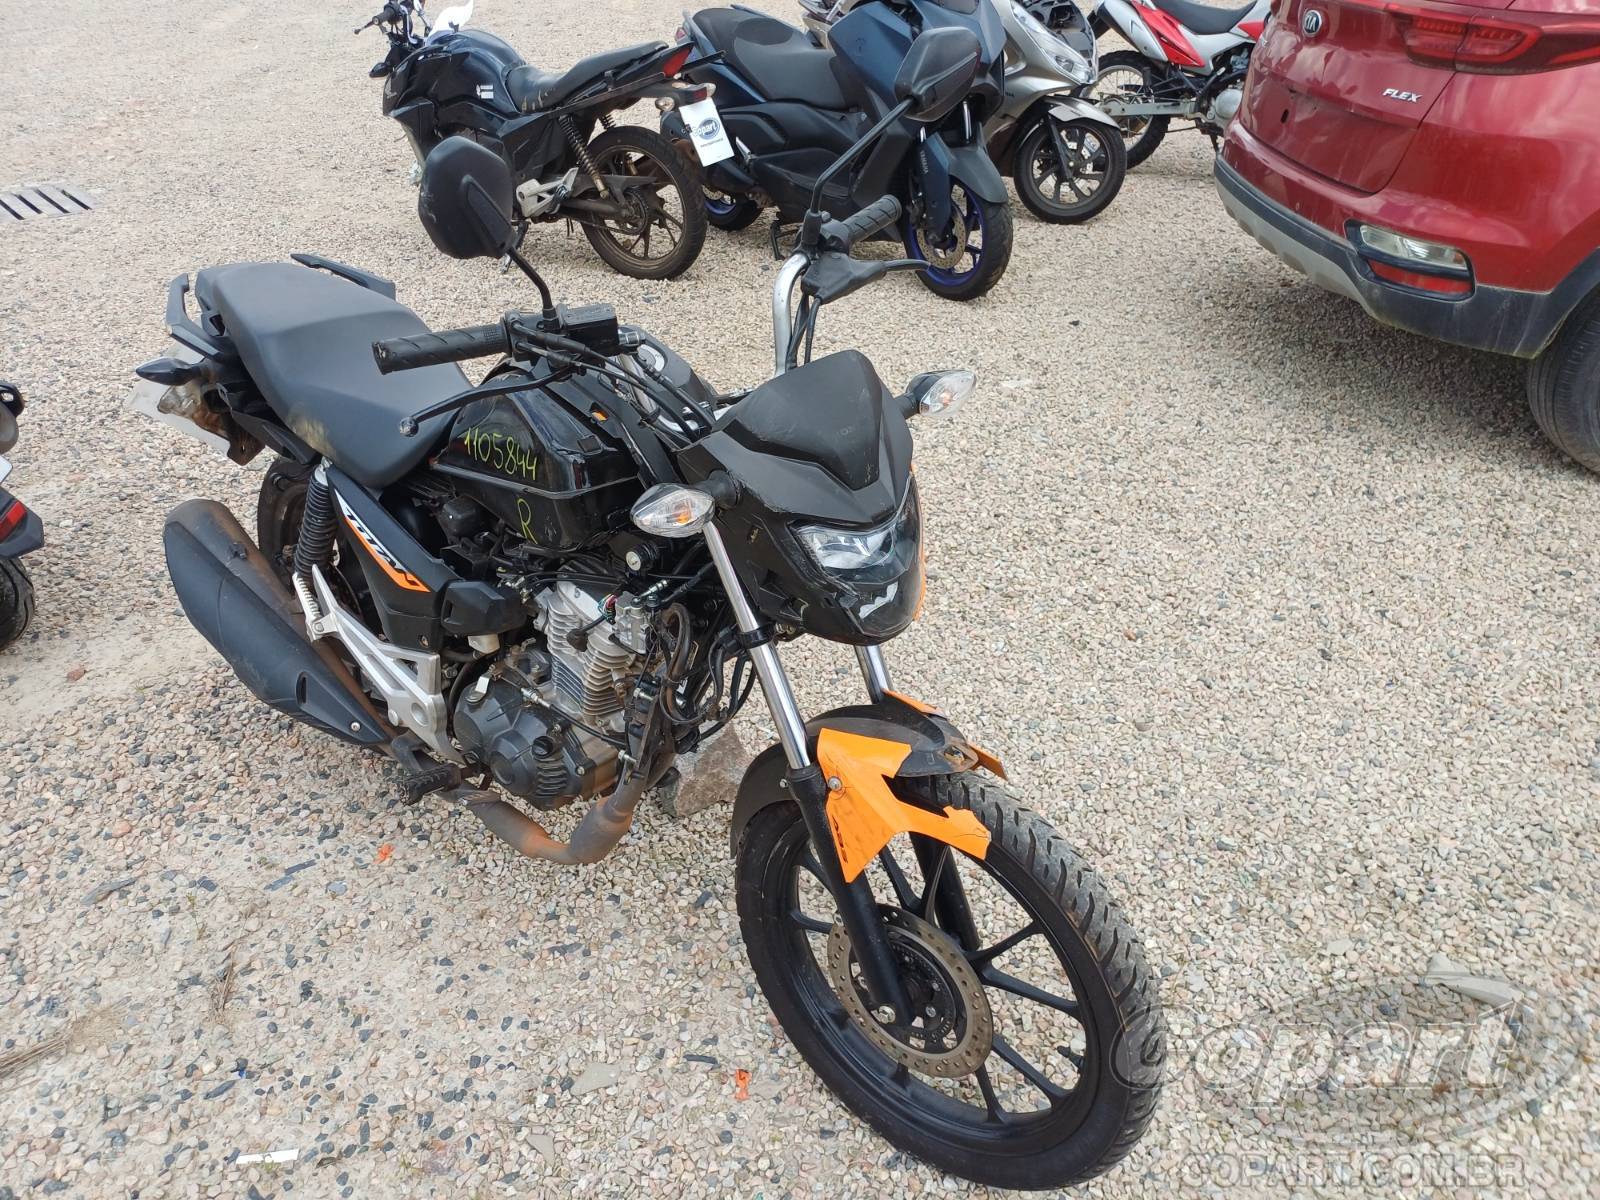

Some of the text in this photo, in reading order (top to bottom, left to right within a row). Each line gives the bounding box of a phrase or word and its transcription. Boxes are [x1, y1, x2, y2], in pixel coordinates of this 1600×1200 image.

[1382, 87, 1423, 103] FLEX
[464, 427, 537, 481] 1105844
[517, 498, 538, 544] R
